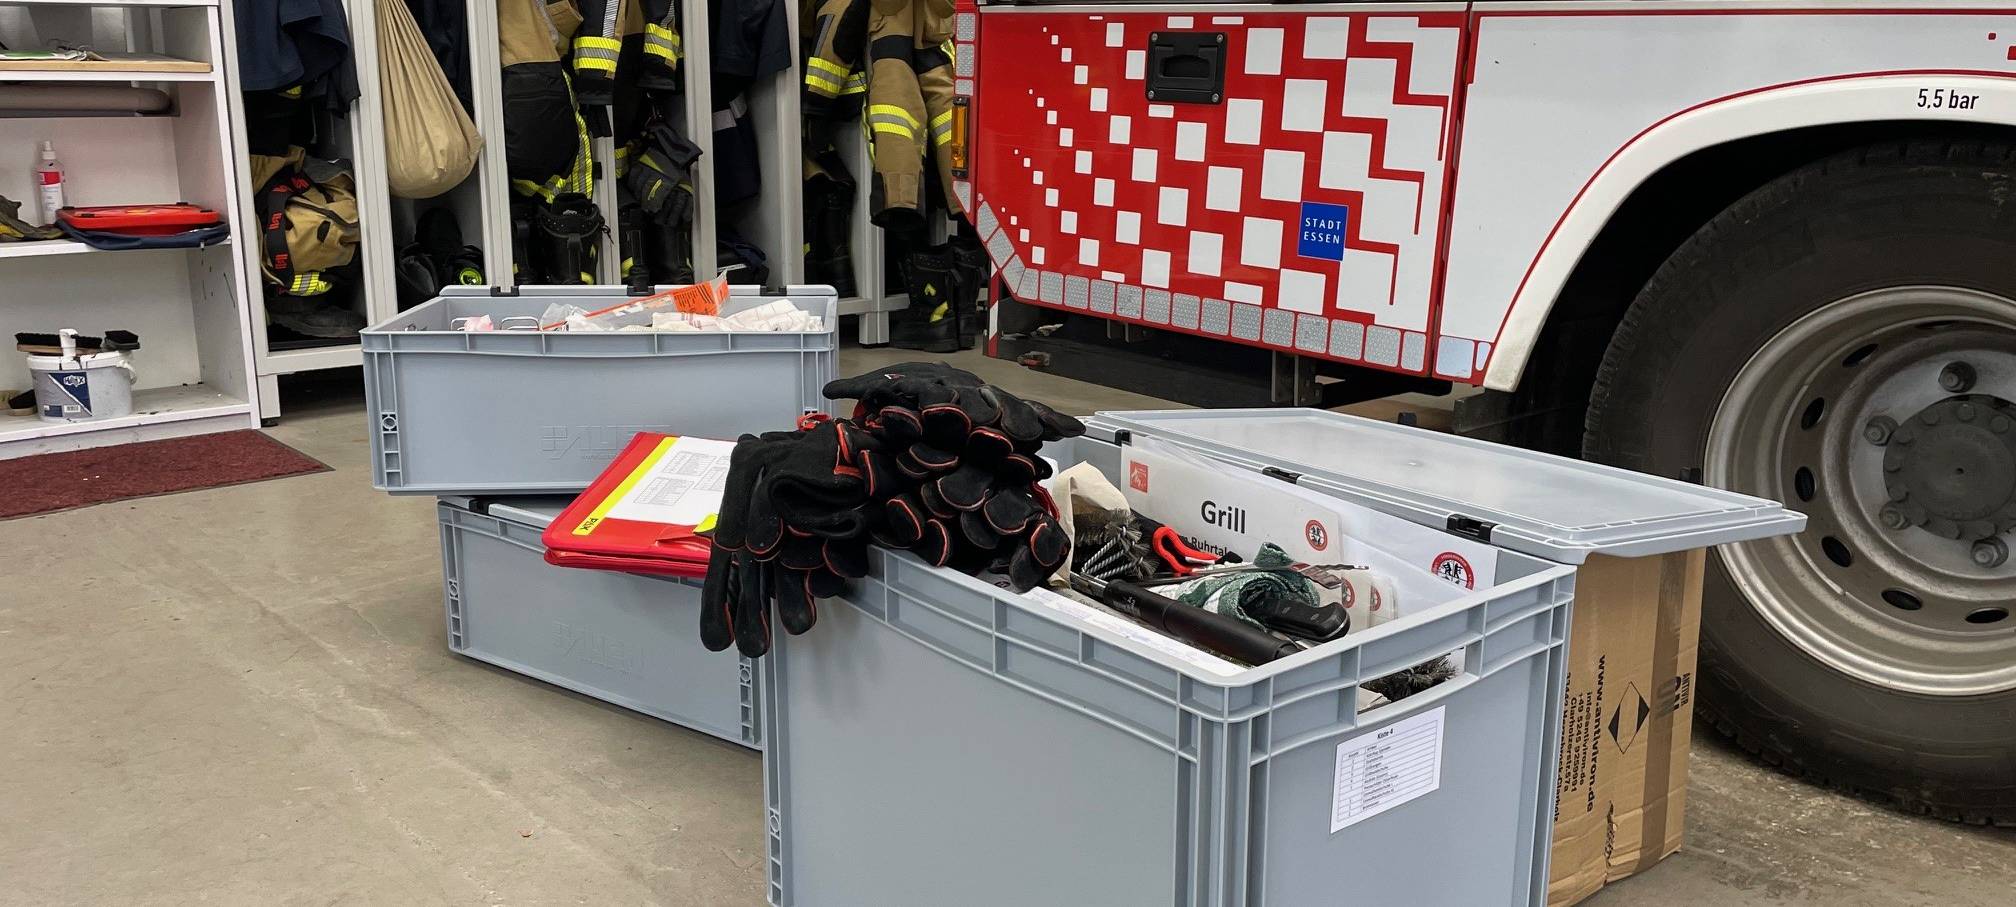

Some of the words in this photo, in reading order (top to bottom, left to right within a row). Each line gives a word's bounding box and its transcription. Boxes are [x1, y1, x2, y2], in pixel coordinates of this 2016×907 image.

[1917, 88, 1944, 109] 5,5
[1948, 89, 1979, 110] bar
[1305, 217, 1342, 231] STADT
[1303, 231, 1340, 244] ESSEN
[1201, 500, 1246, 534] Grill
[1191, 536, 1227, 556] Ruhrtal
[1575, 715, 1583, 743] 5245
[1579, 691, 1592, 786] info@antiviron.de
[1587, 654, 1606, 813] www.antiviron.de
